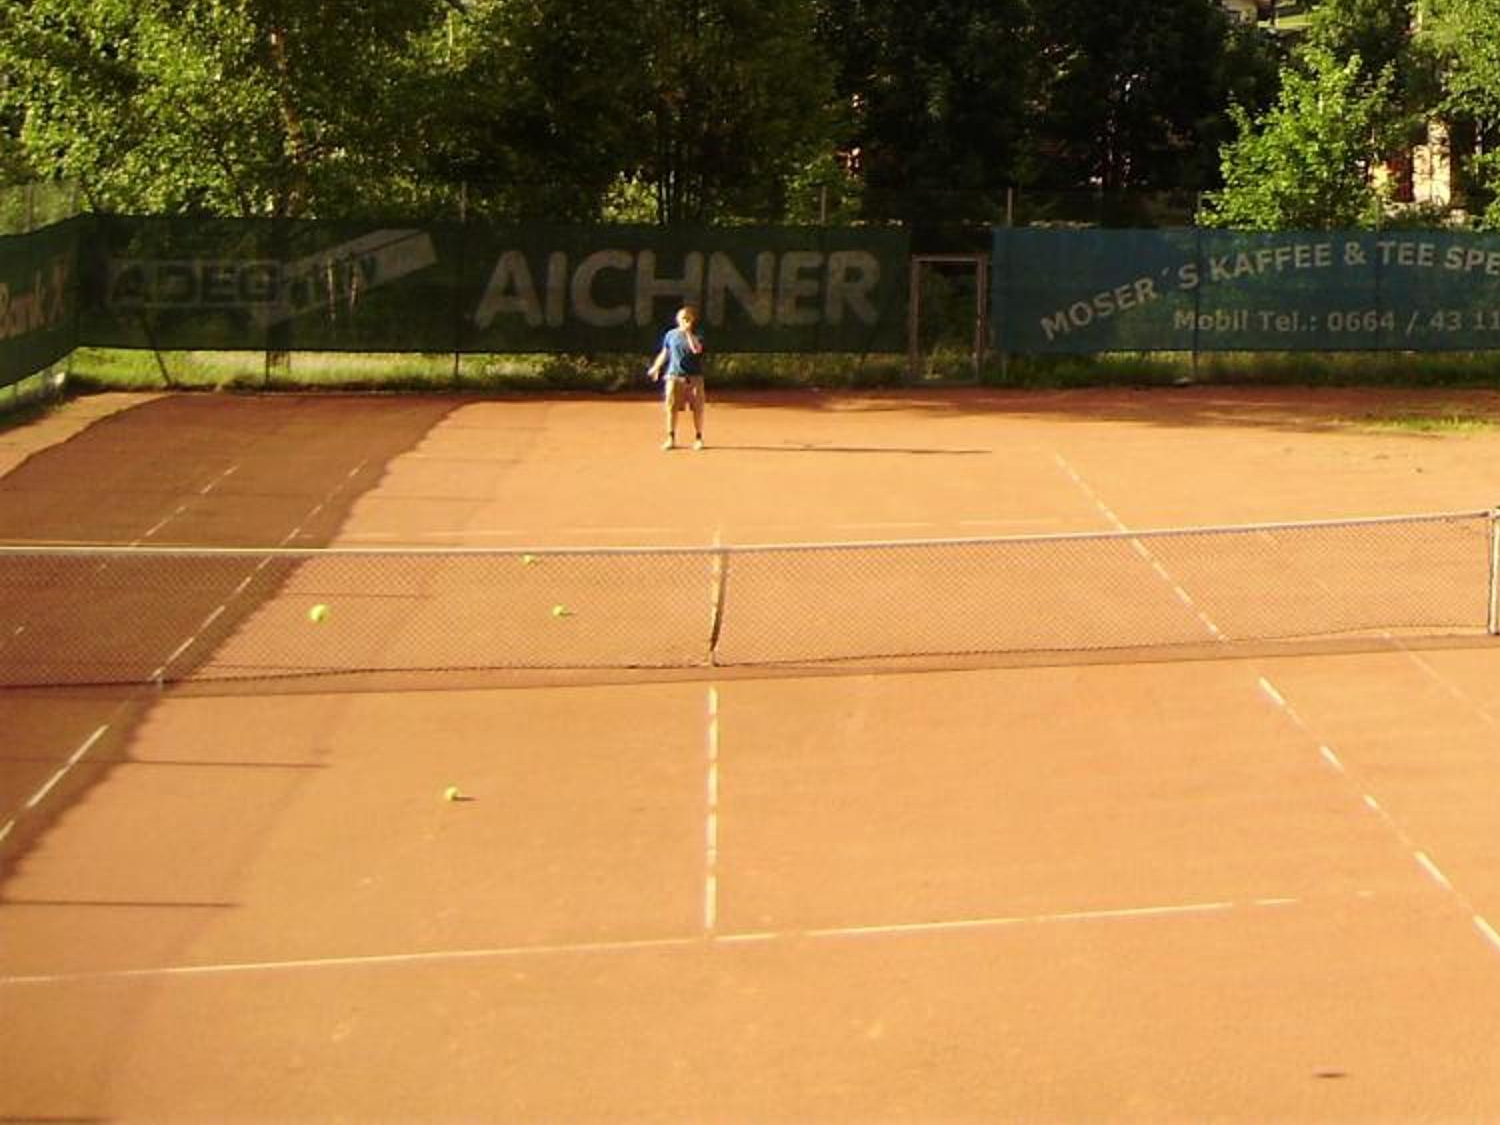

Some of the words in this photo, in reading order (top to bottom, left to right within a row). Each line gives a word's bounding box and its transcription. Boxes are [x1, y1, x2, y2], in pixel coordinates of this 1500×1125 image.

[1210, 241, 1332, 282] KAFFEE
[1343, 241, 1367, 266] &
[1379, 240, 1434, 268] TEE
[475, 249, 881, 329] AICHNER
[1173, 309, 1248, 332] Mobil
[1258, 310, 1317, 332] Tel.:
[1327, 310, 1395, 332] 0664
[1406, 310, 1418, 336] /
[1429, 310, 1462, 332] 43
